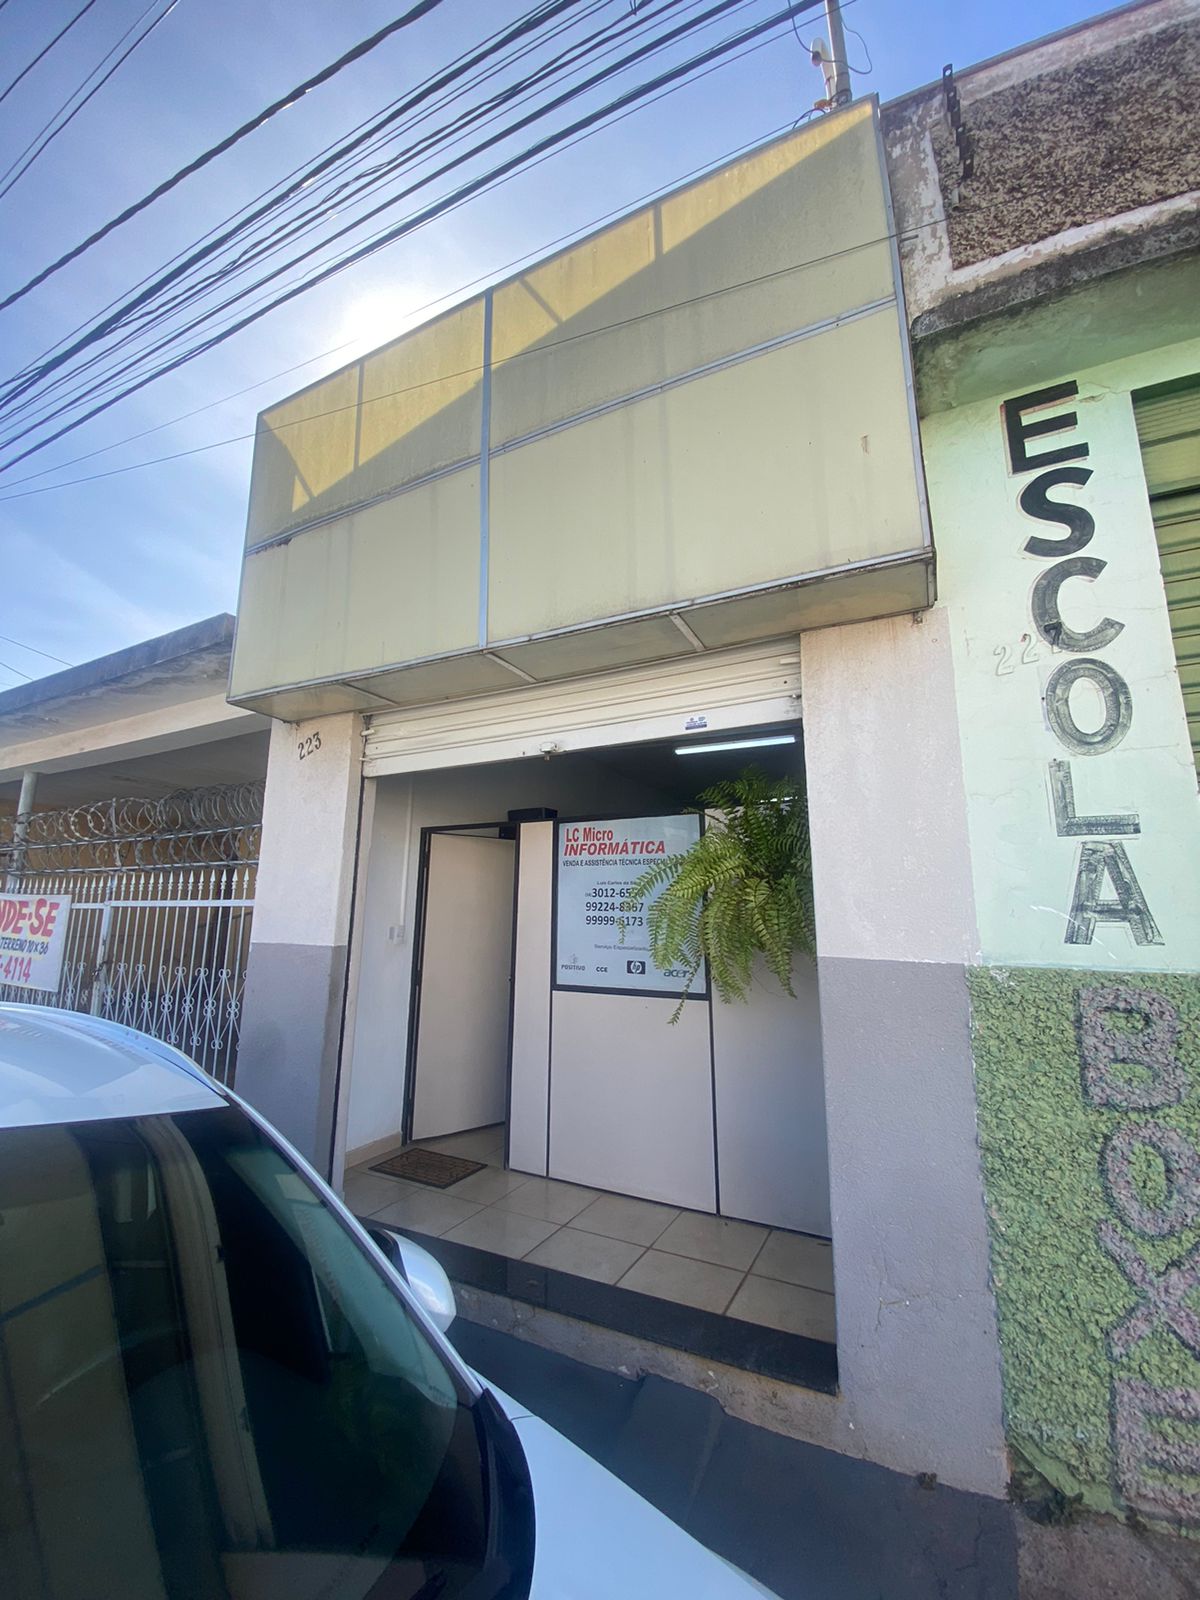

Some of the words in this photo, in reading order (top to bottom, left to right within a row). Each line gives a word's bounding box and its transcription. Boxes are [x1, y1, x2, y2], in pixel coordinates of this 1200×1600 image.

[1001, 380, 1165, 946] ESCOLA
[298, 731, 321, 760] 223
[566, 828, 579, 843] LC
[583, 827, 613, 842] Micro
[564, 838, 665, 856] INFORMÁTICA
[585, 859, 618, 867] ASSISTÊNCIA
[619, 858, 641, 866] TÉCNICA
[663, 968, 690, 978] acer
